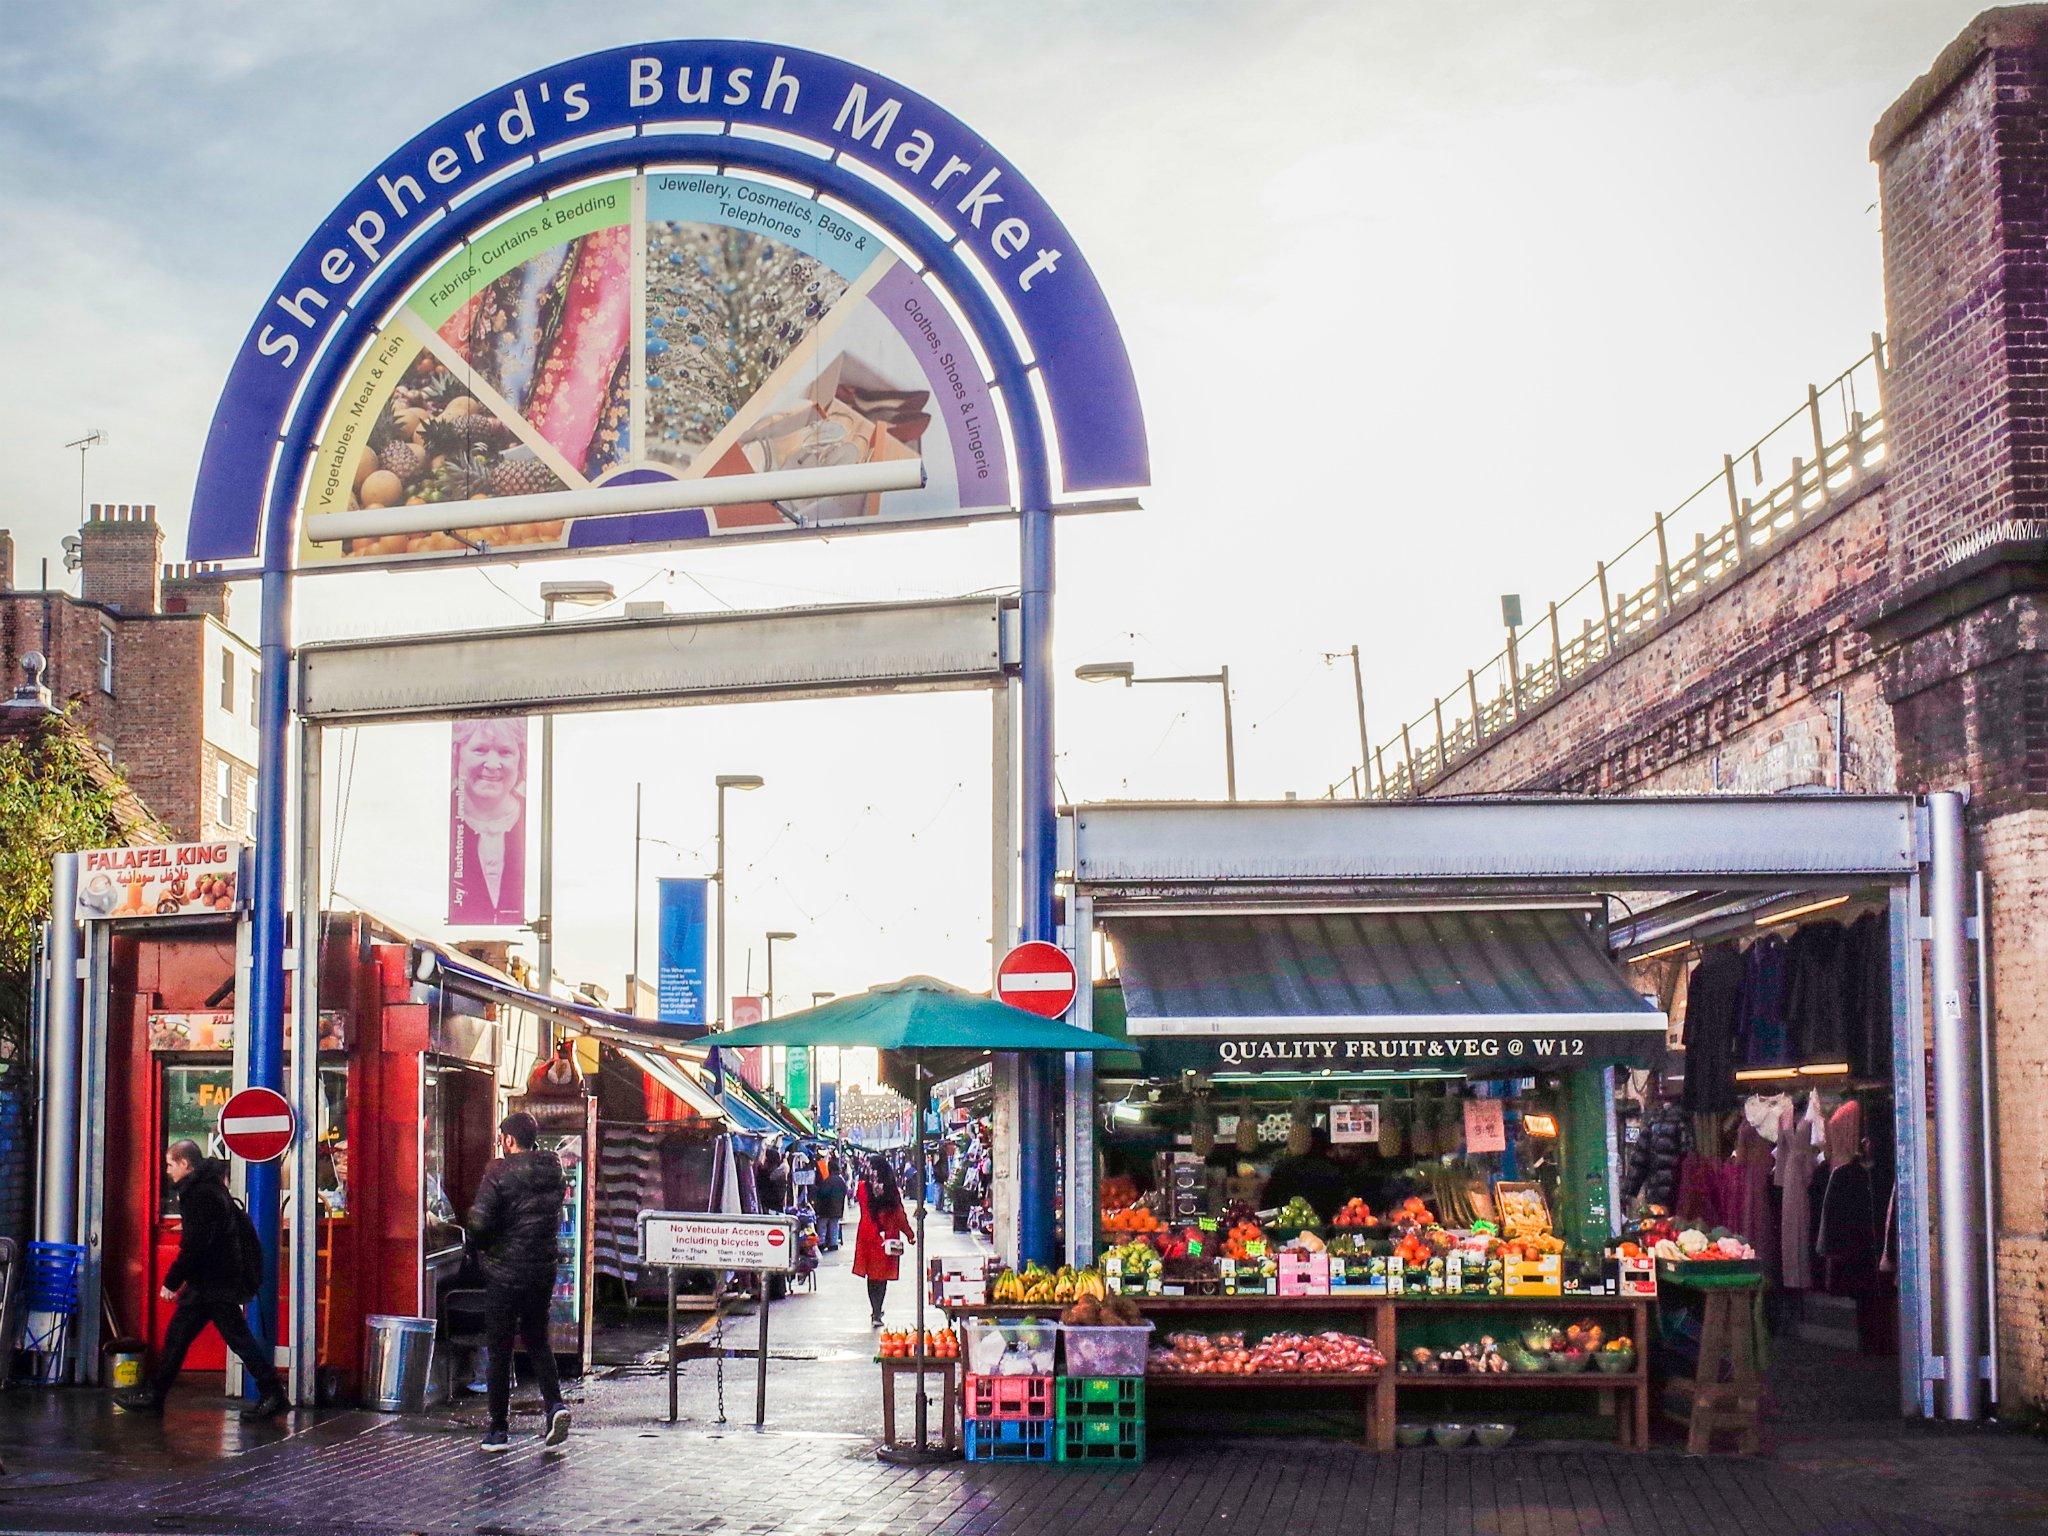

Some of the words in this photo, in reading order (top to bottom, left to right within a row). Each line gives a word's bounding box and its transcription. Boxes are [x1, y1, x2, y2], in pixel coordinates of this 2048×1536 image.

[257, 81, 590, 369] Shepherd's
[629, 55, 802, 115] Bush
[832, 84, 1063, 293] Market
[659, 177, 732, 199] Jewellery,
[737, 186, 813, 224] Cosmetics,
[817, 214, 853, 243] Bags
[854, 236, 868, 252] &
[718, 202, 802, 239] Telephones
[429, 264, 482, 308] Fabrics,
[481, 227, 538, 265] Curtains
[541, 217, 553, 231] &
[555, 194, 616, 225] Bedding
[904, 298, 942, 355] Clothes,
[939, 353, 966, 400] Shoes
[319, 421, 359, 506] Vegetables,
[350, 381, 377, 415] Meat
[371, 368, 383, 379] &
[379, 335, 405, 367] Fish
[960, 402, 974, 416] &
[965, 416, 988, 479] Lingerie
[87, 847, 172, 871] FALAFEL
[176, 844, 228, 866] KING
[454, 824, 464, 877] Bushstores
[454, 888, 468, 907] Joy
[1218, 1040, 1337, 1064] QUALITY
[1345, 1039, 1500, 1058] FRUIT&VEG
[1507, 1040, 1524, 1056] @
[1533, 1039, 1584, 1056] W12
[686, 1225, 729, 1235] Vehicular
[732, 1227, 765, 1236] Access
[721, 1237, 760, 1247] bicycles
